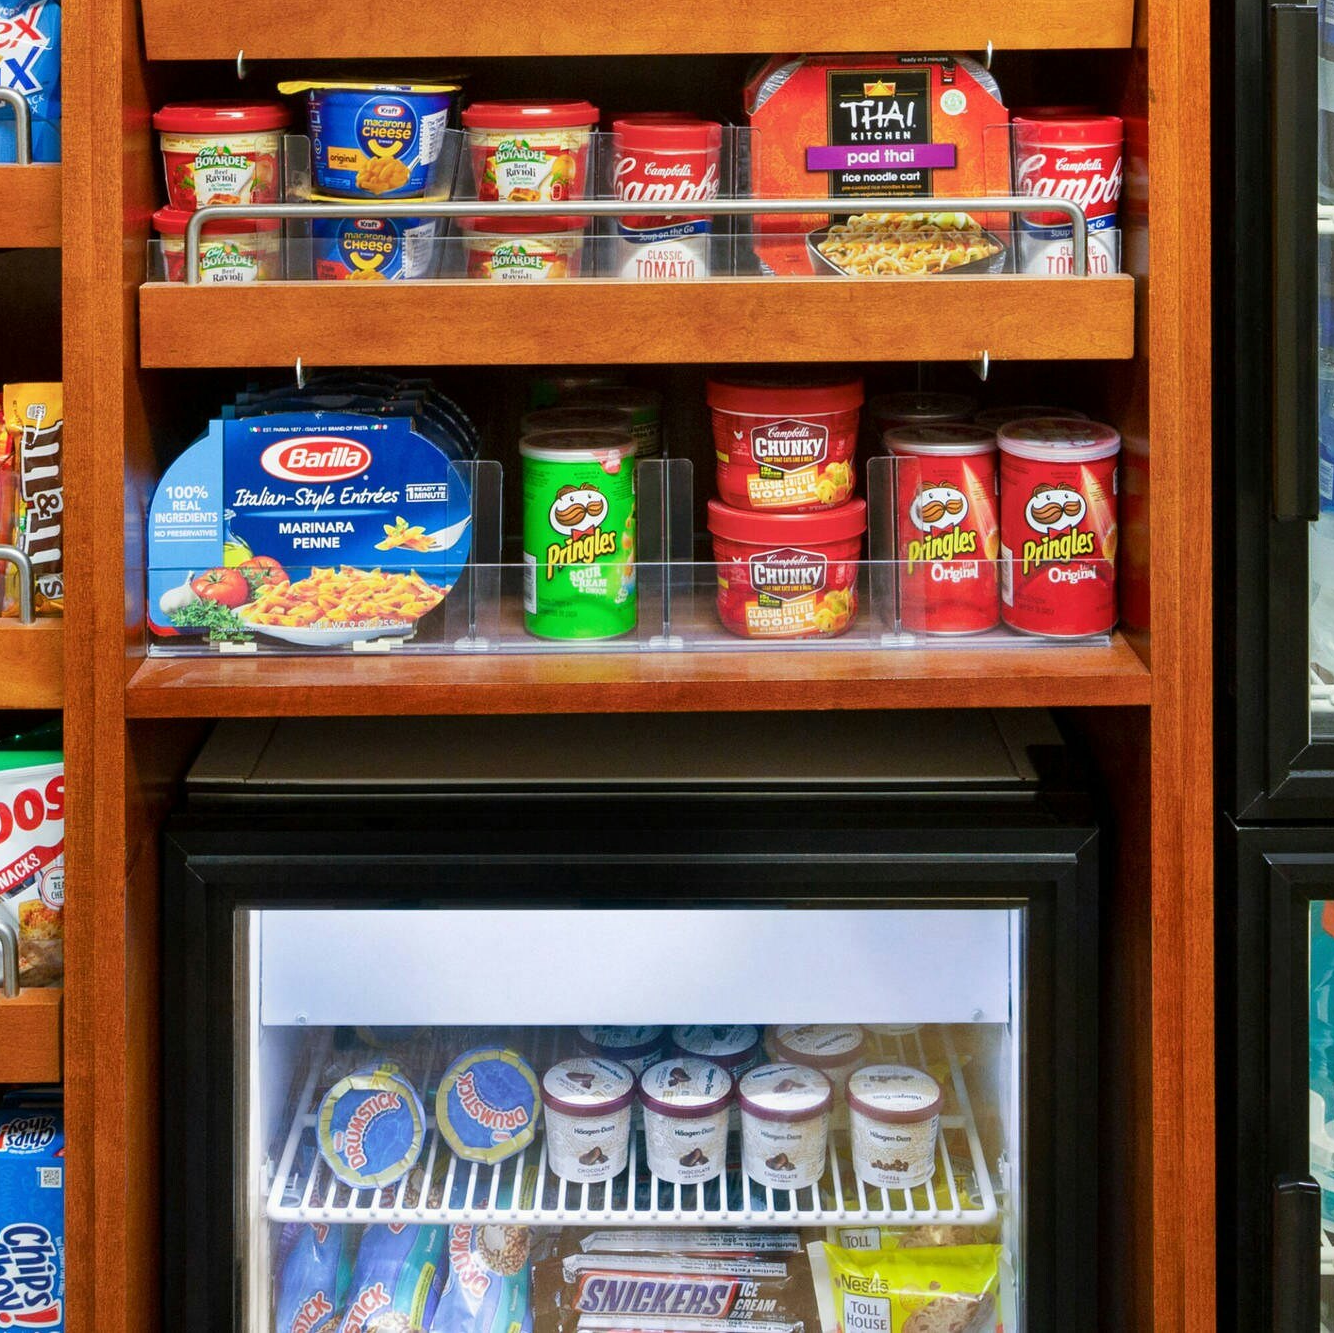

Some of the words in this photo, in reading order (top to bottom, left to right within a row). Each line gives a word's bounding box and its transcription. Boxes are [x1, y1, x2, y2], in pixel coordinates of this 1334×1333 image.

[380, 107, 399, 115] Kraft
[839, 100, 916, 130] THAI
[850, 131, 912, 141] KITCHEN
[194, 155, 247, 169] BOYARDEE
[330, 152, 357, 165] original
[495, 150, 547, 163] BOYARDEE
[847, 149, 880, 166] pad
[884, 149, 915, 163] thai
[205, 173, 237, 184] Ravioli
[506, 167, 537, 178] Ravioli
[842, 173, 862, 183] rice
[863, 172, 898, 183] noodle
[899, 171, 920, 182] cart
[202, 255, 254, 268] BOYARDEE
[491, 255, 543, 267] BOYARDEE
[647, 249, 683, 260] CLASSIC
[635, 258, 695, 278] TOMATO
[212, 273, 243, 283] Ravioli
[755, 437, 823, 456] CHUNKY
[287, 448, 363, 468] Barilla
[166, 485, 208, 500] 100%
[406, 486, 414, 500] 1
[414, 492, 447, 500] MINUTE
[750, 483, 816, 499] NOODLE
[172, 501, 201, 511] REAL
[233, 486, 335, 513] Italian-Style
[340, 485, 399, 504] Entrées
[155, 512, 218, 523] INGREDIENTS
[163, 529, 218, 537] PRESERVATIVES
[278, 521, 354, 534] MARINARA
[292, 536, 340, 549] PENNE
[548, 530, 616, 580] Pringles
[907, 527, 976, 575] Pringles
[1023, 528, 1094, 575] Pringles
[569, 567, 601, 581] SOUR
[754, 565, 823, 585] CHUNKY
[931, 561, 978, 583] Original
[1048, 566, 1096, 584] Original
[572, 577, 607, 588] CREAM
[748, 613, 815, 627] NOODLE
[455, 1071, 529, 1130] DRUMSTICK
[345, 1091, 402, 1170] DRUMSTICK
[844, 1235, 872, 1248] TOLL
[2, 1225, 56, 1309] Chips
[738, 1281, 759, 1297] ICE
[580, 1279, 733, 1317] SNICKERS
[734, 1296, 777, 1313] CREAM
[851, 1299, 882, 1316] TOLL
[846, 1314, 889, 1331] HOUSE
